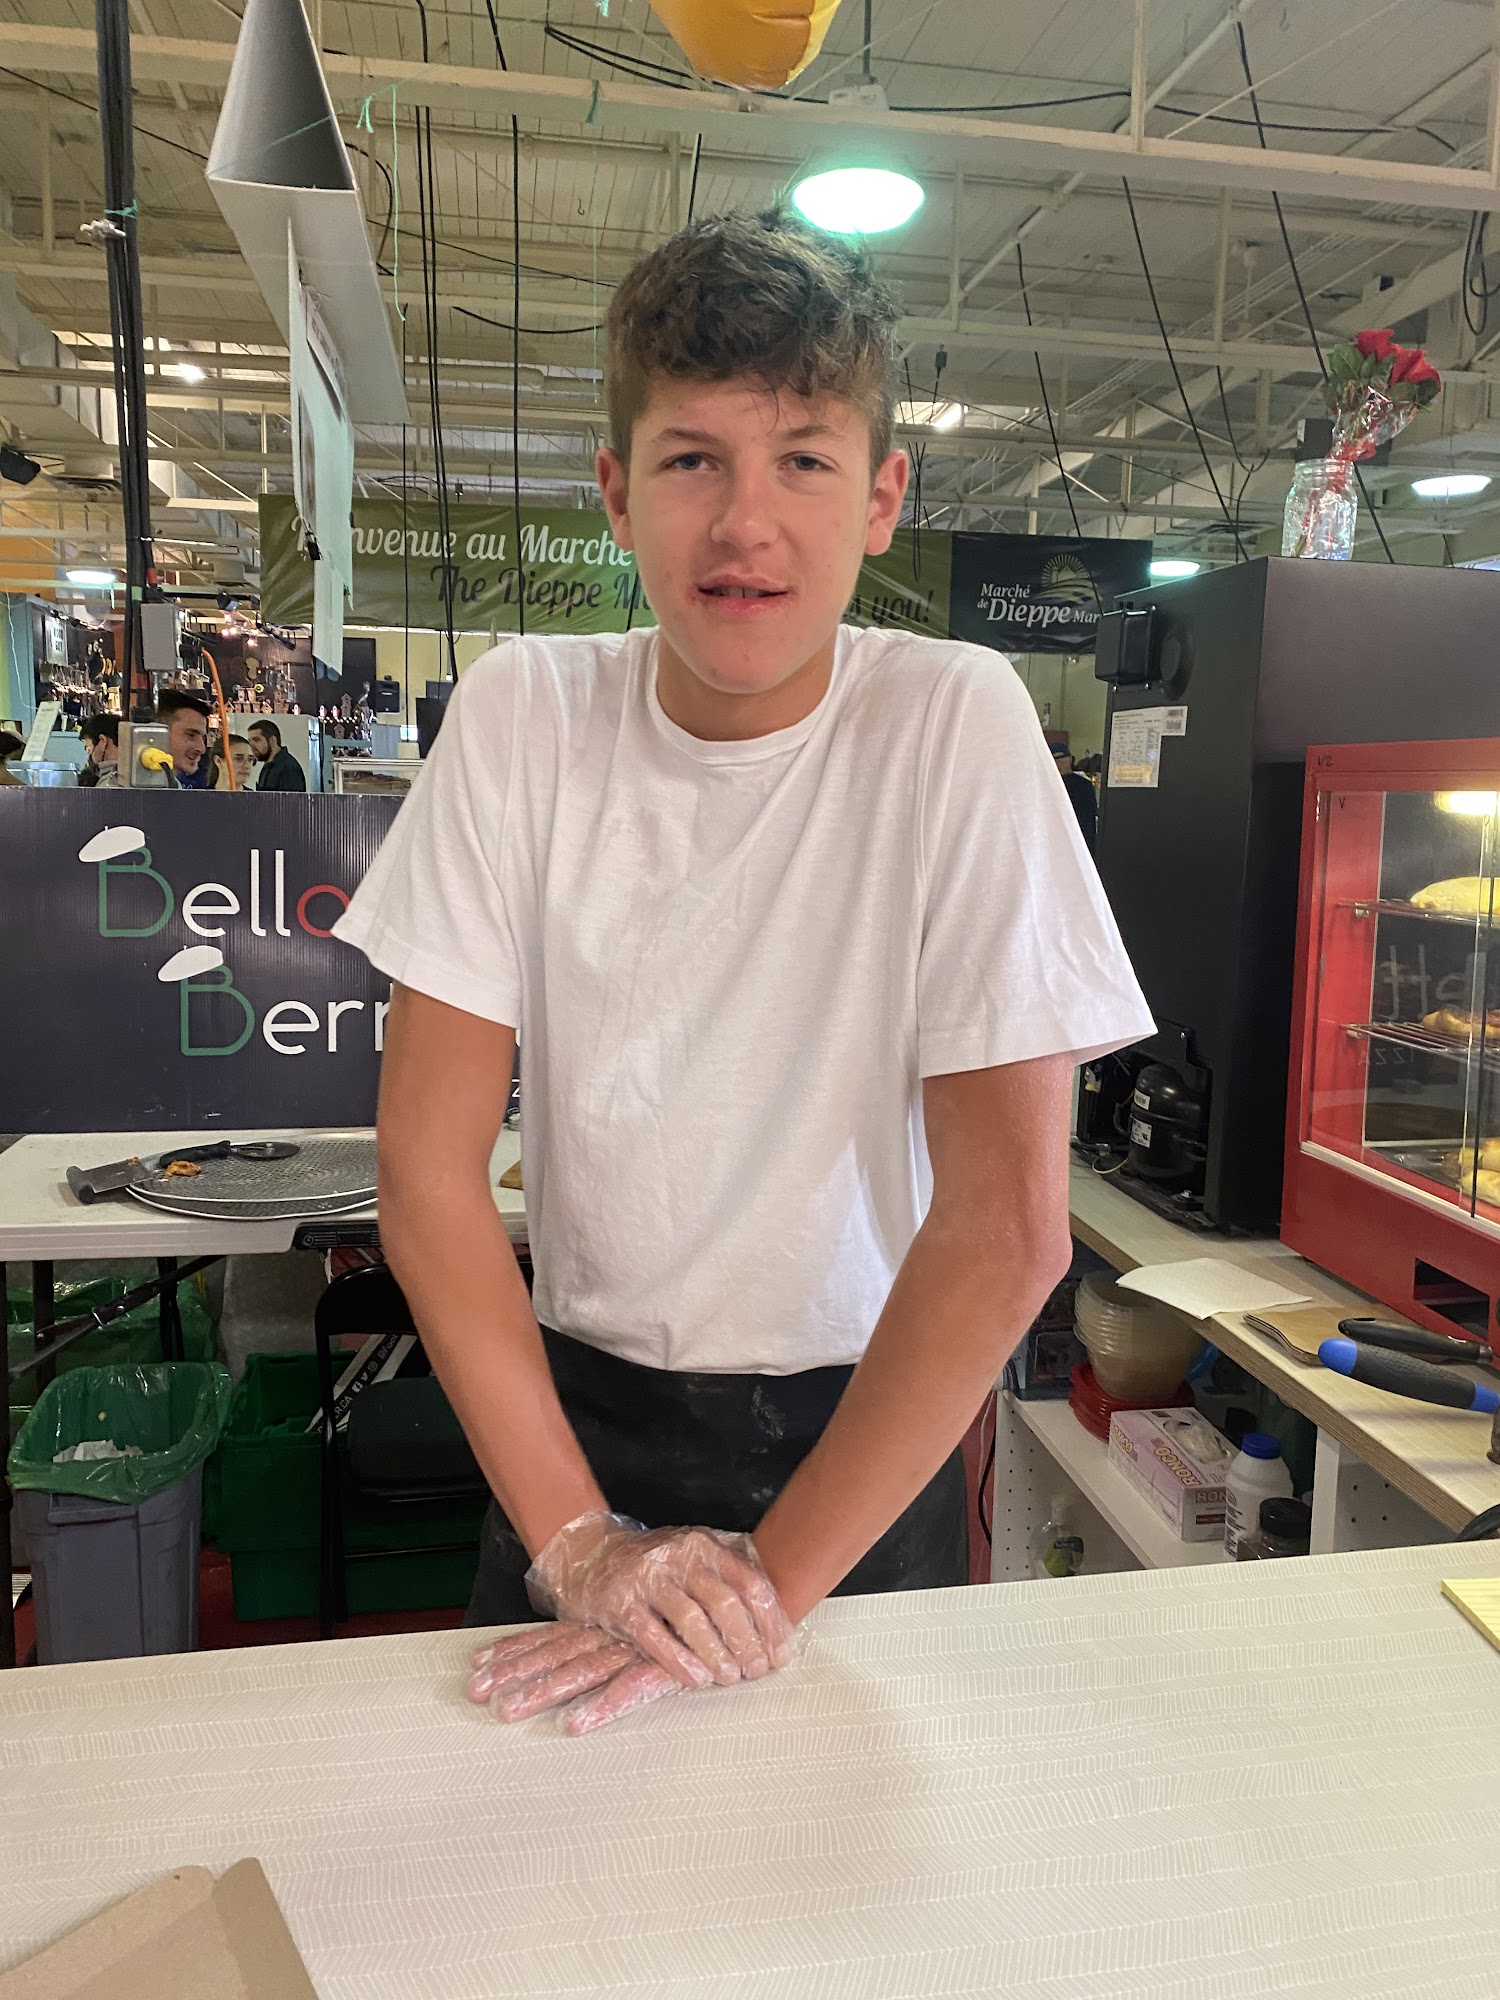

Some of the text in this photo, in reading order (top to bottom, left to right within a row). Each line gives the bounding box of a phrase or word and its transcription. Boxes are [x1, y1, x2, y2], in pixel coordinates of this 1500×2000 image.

[466, 532, 506, 561] au
[430, 564, 487, 603] The
[498, 567, 602, 618] Dieppe
[872, 589, 935, 627] you!
[980, 583, 1031, 598] Marché
[977, 599, 989, 609] de
[986, 597, 1071, 629] Dieppe
[1153, 1445, 1203, 1487] RONCO
